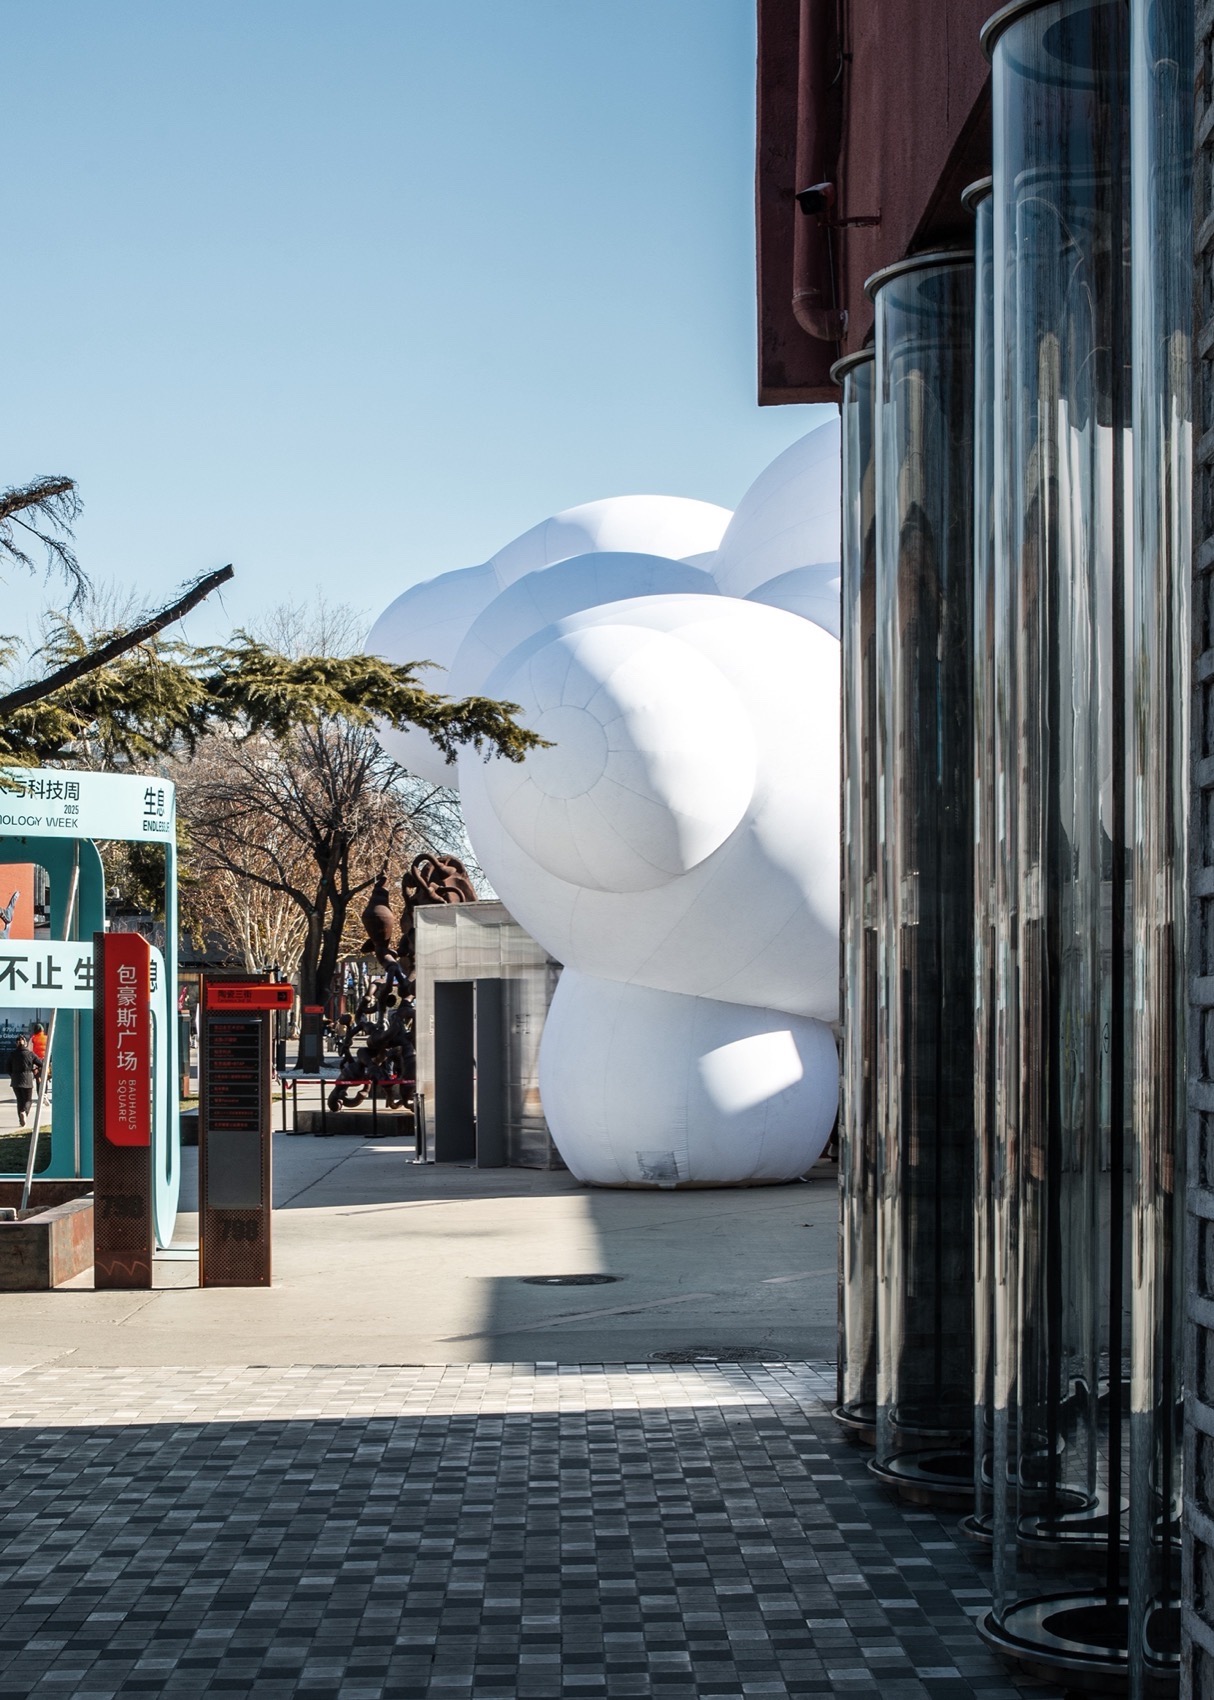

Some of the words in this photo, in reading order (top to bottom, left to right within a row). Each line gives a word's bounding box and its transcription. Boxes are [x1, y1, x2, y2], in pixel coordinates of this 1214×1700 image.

[46, 817, 79, 828] WEEK
[64, 804, 79, 815] 2025
[117, 964, 137, 1071] 包豪斯广场
[117, 1080, 127, 1122] SQUARE
[128, 1080, 137, 1130] BAUHAUS
